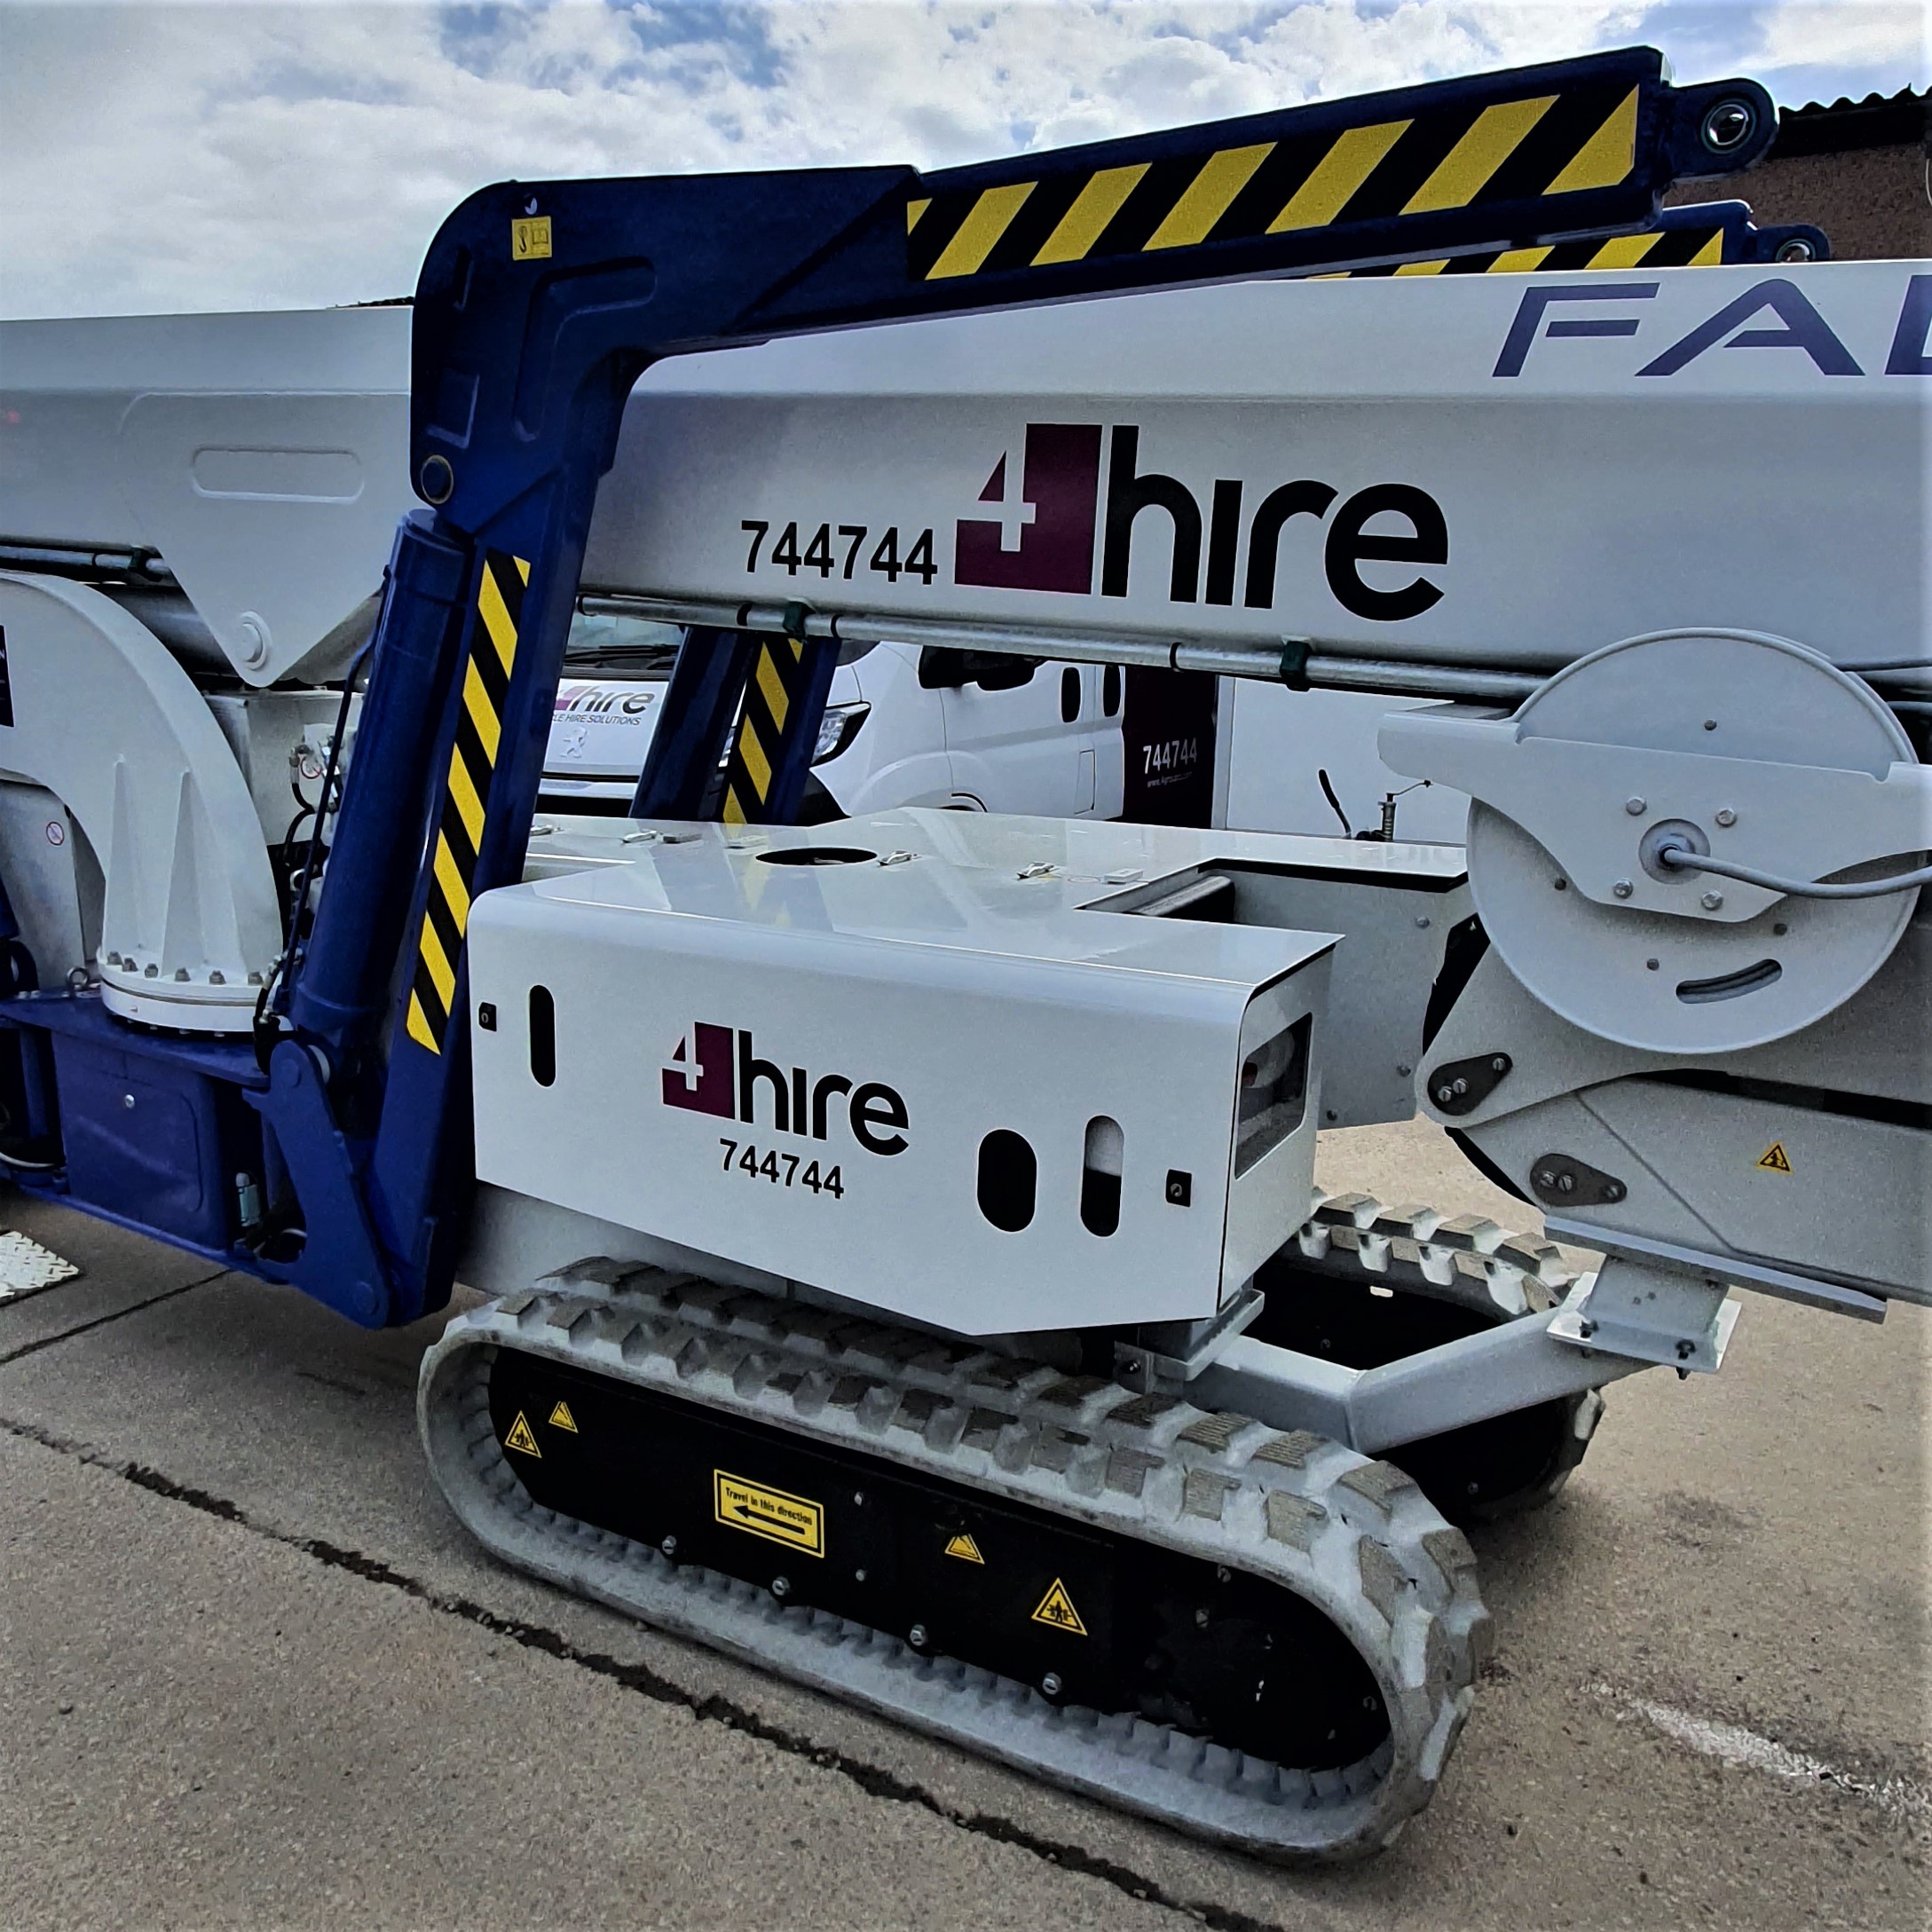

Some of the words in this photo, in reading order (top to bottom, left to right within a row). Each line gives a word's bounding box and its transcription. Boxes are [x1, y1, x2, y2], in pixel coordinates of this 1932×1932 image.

[740, 519, 938, 585] 744744
[565, 714, 586, 723] HIRE
[587, 714, 642, 726] SOLUTIONS
[1143, 737, 1197, 775] 744744
[719, 1137, 844, 1200] 744744
[725, 1486, 748, 1503] Travel
[750, 1495, 758, 1507] in
[760, 1499, 775, 1513] this
[777, 1506, 812, 1526] direction
